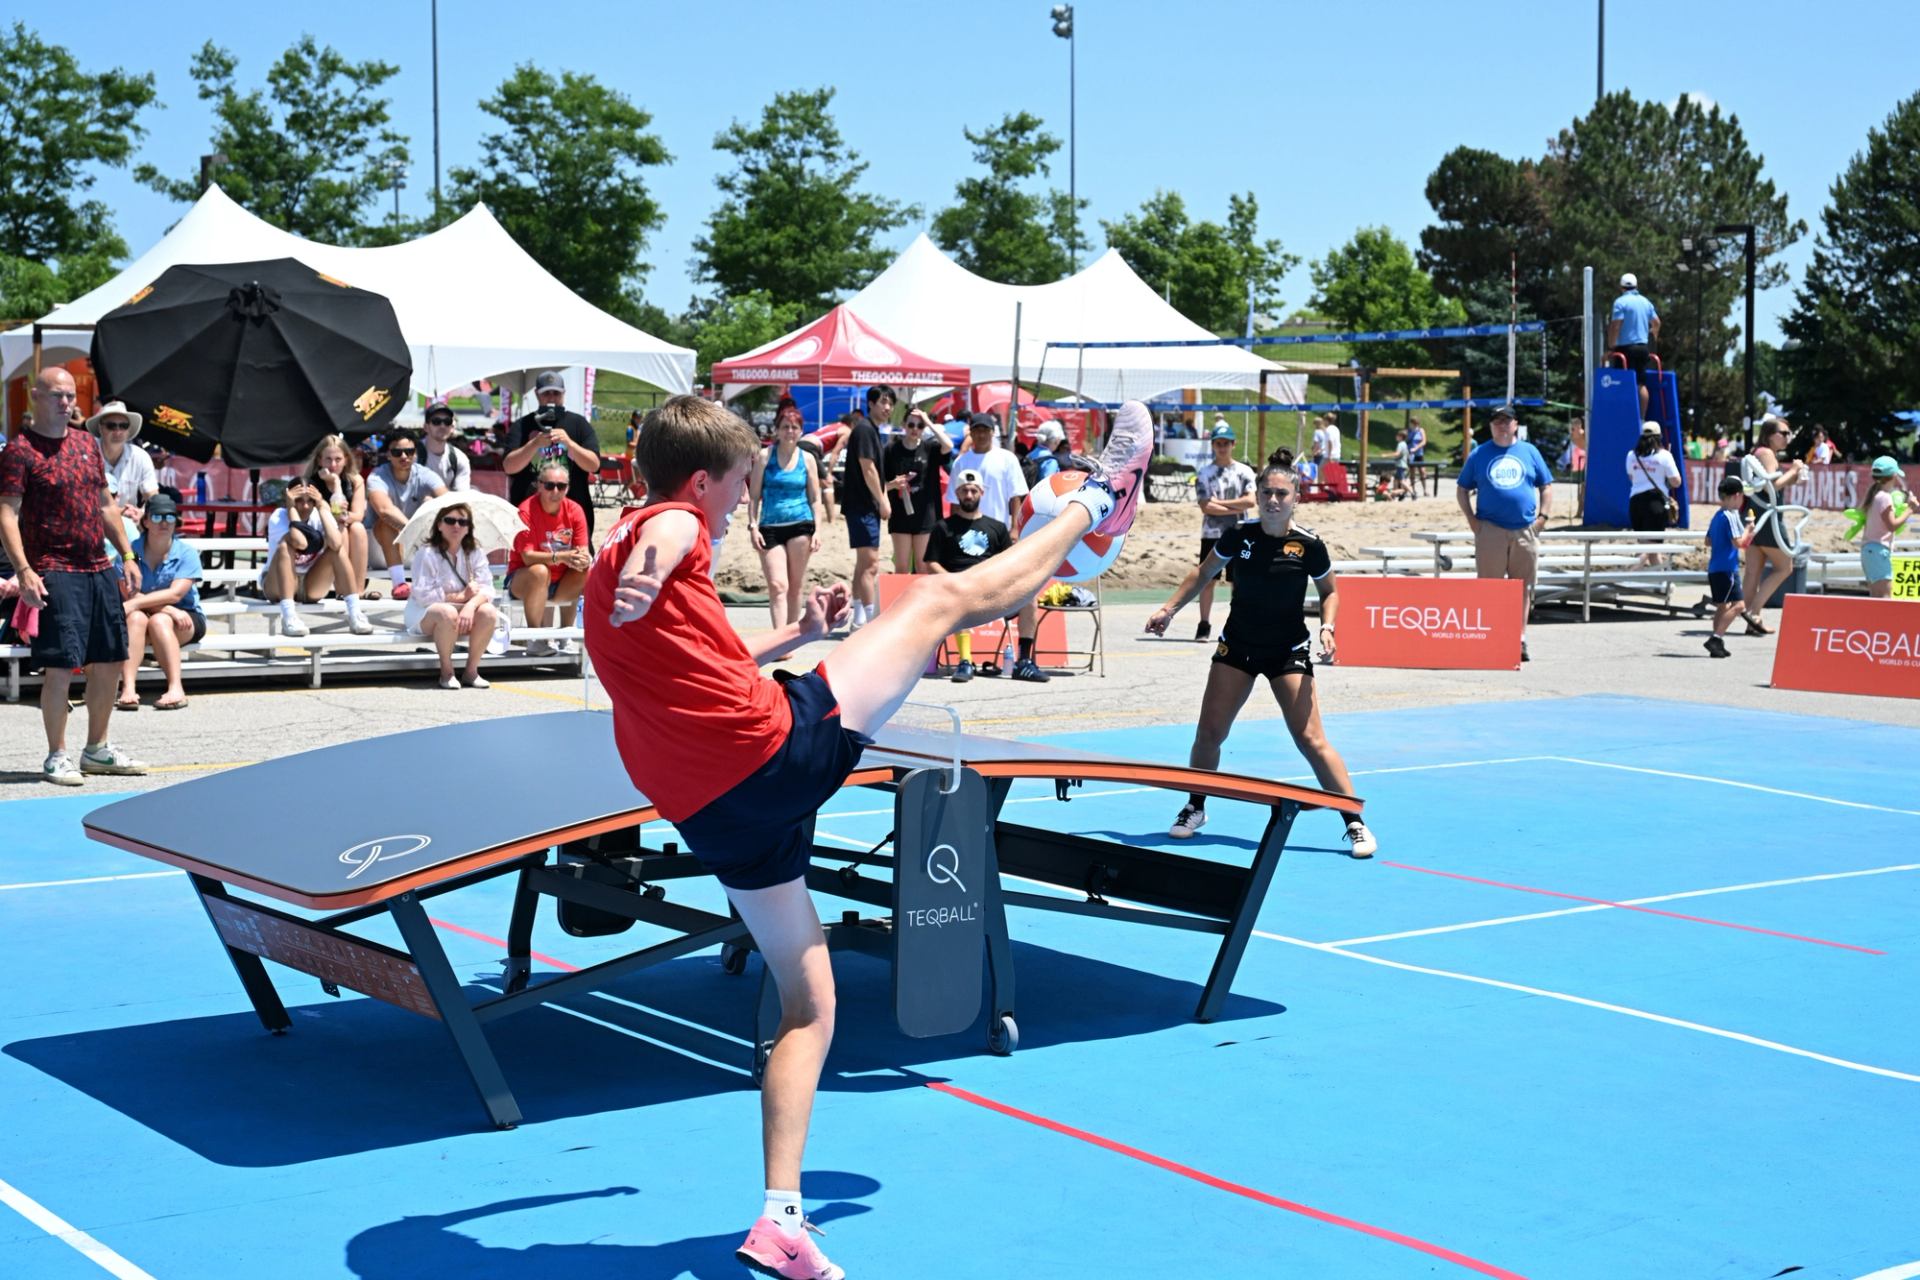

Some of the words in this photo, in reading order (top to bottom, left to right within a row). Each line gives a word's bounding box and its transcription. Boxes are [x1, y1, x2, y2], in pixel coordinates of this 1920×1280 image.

[1790, 470, 1858, 509] GAMES
[1895, 572, 1920, 584] SA
[1893, 585, 1920, 597] JE
[1365, 606, 1492, 636] TEQBALL
